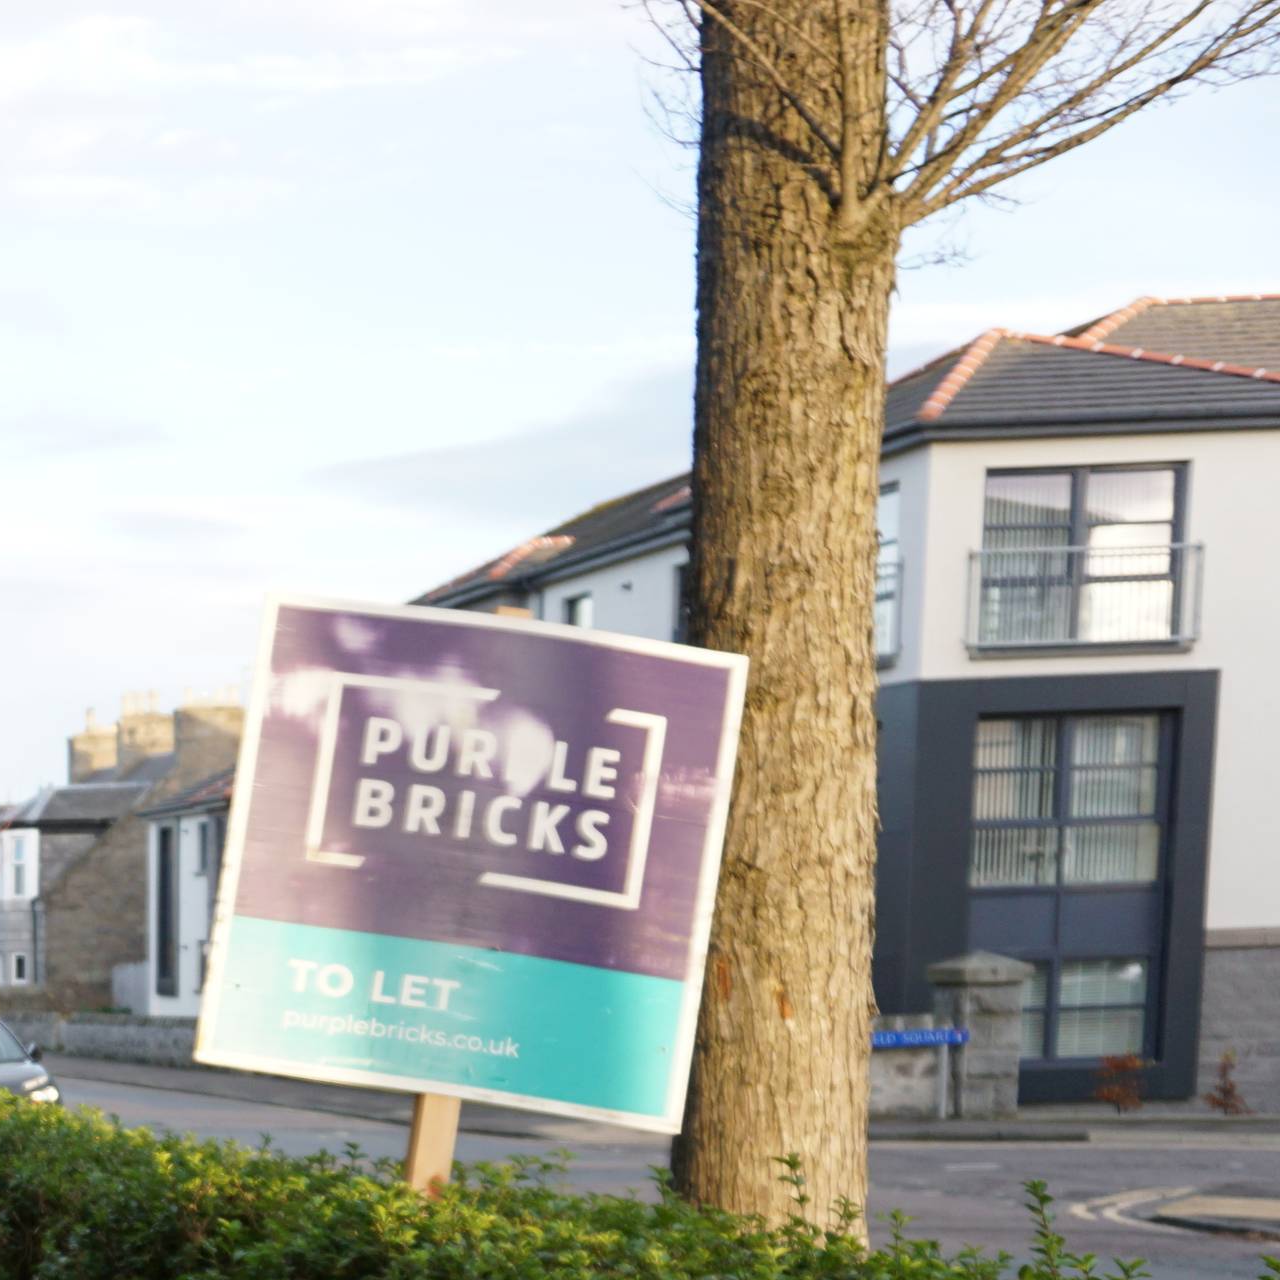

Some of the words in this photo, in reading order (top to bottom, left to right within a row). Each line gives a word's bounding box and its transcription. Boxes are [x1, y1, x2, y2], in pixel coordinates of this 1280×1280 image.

[361, 716, 621, 799] PURLE
[353, 778, 610, 861] BRICKS
[288, 958, 354, 998] TO
[370, 970, 461, 1012] LET
[281, 1010, 520, 1059] purplebricks.co.uk
